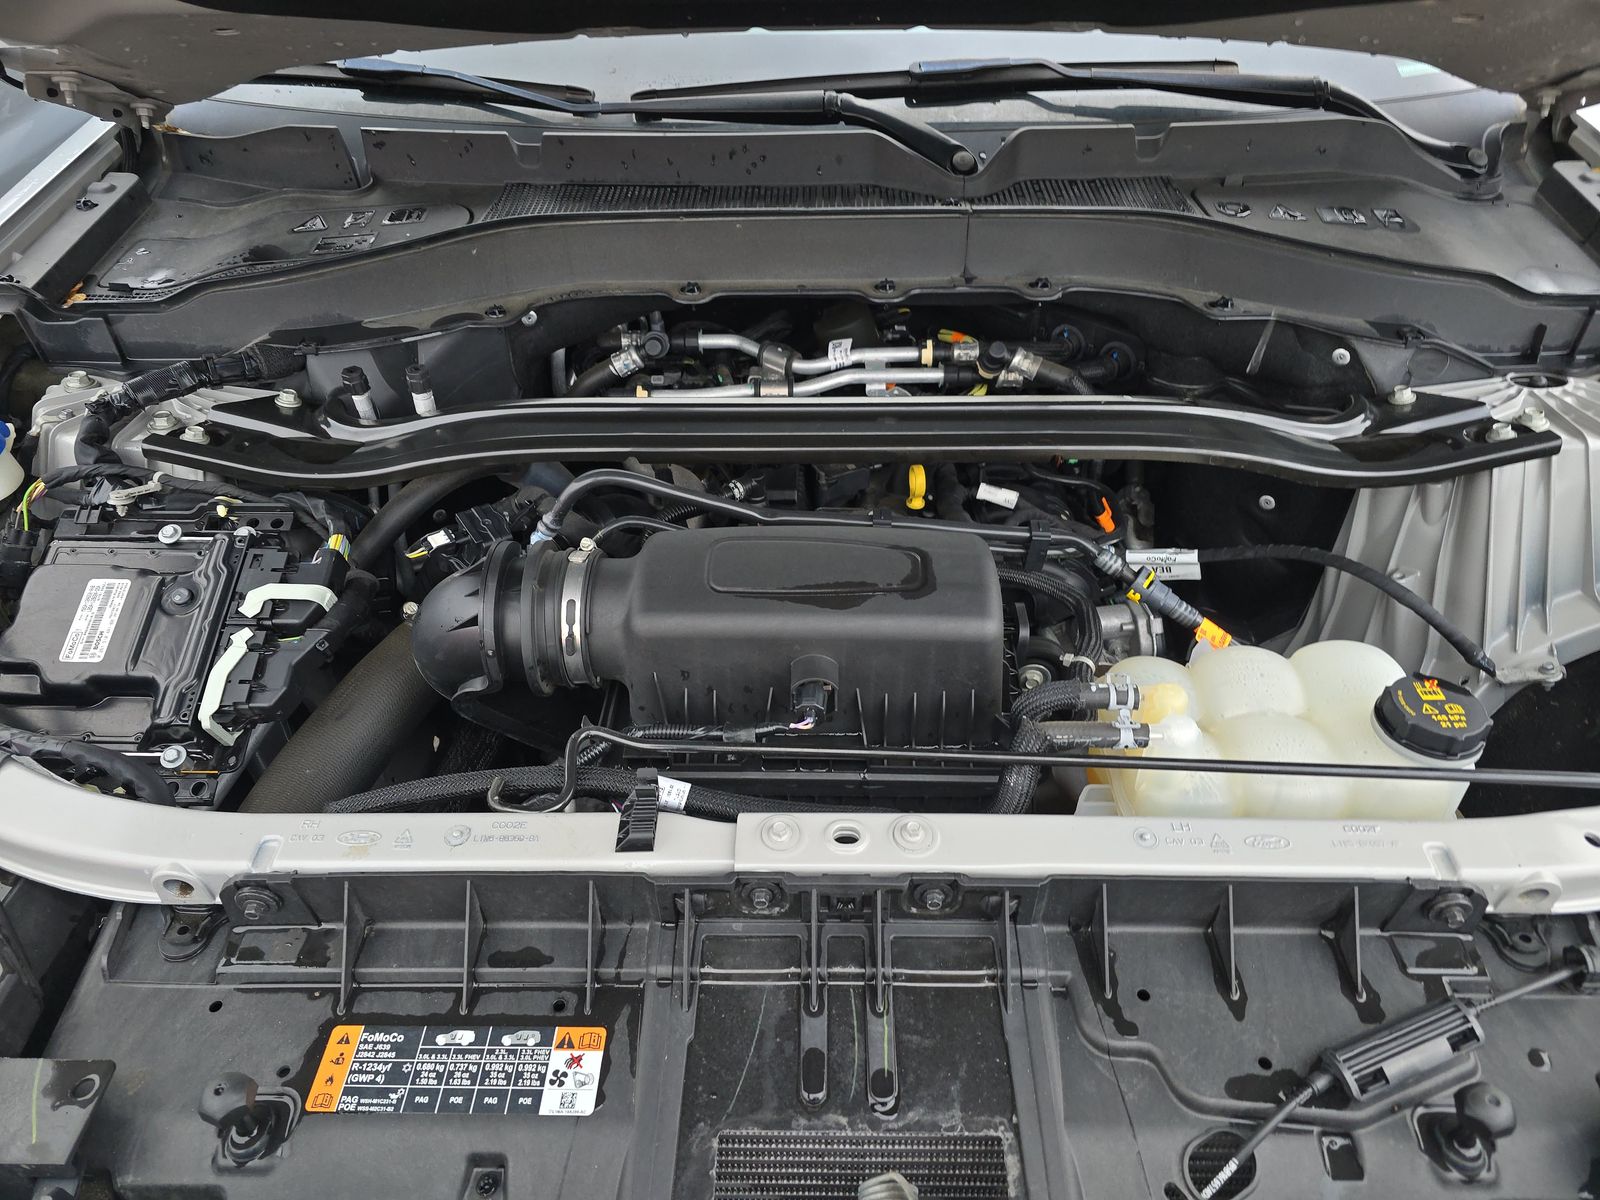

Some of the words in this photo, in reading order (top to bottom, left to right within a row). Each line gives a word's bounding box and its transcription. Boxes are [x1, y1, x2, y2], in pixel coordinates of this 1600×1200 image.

[361, 1032, 405, 1043] FoMoCo
[351, 1062, 392, 1073] R-1234yf
[435, 1063, 445, 1073] kg
[468, 1063, 478, 1073] kg
[485, 1063, 504, 1071] 0.992
[504, 1064, 513, 1073] kg
[518, 1064, 537, 1072] 0.992
[537, 1064, 547, 1074] kg
[347, 1073, 375, 1084] (GWP
[375, 1073, 385, 1085] 4)
[340, 1095, 359, 1103] PAG
[449, 1096, 463, 1104] POE
[483, 1096, 498, 1104] PAG
[518, 1097, 533, 1105] POE
[338, 1103, 357, 1111] POE
